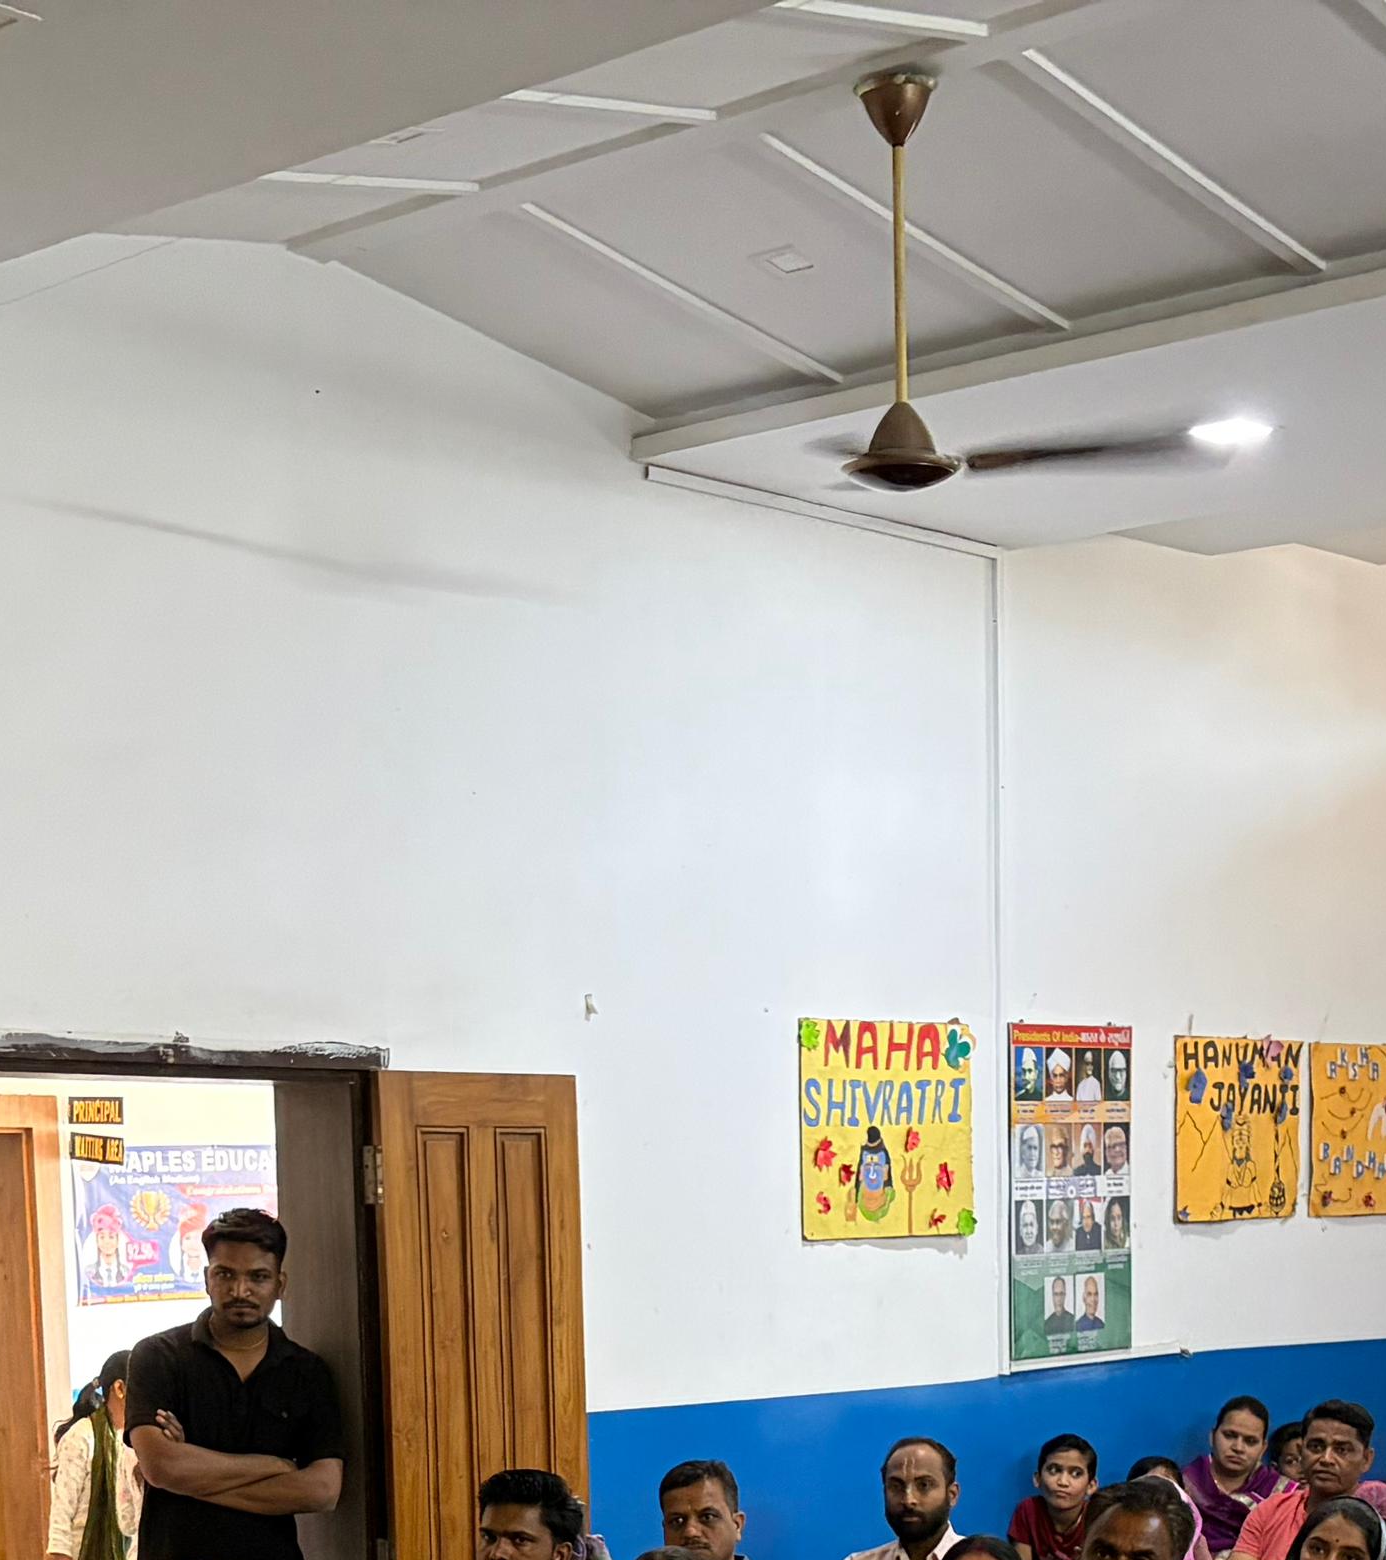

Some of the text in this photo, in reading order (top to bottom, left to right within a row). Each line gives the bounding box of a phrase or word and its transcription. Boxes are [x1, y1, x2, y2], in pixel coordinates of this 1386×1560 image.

[824, 1020, 940, 1071] MAHA
[73, 1099, 121, 1123] PRINCIPAL
[803, 1078, 966, 1127] SHIVRATRI
